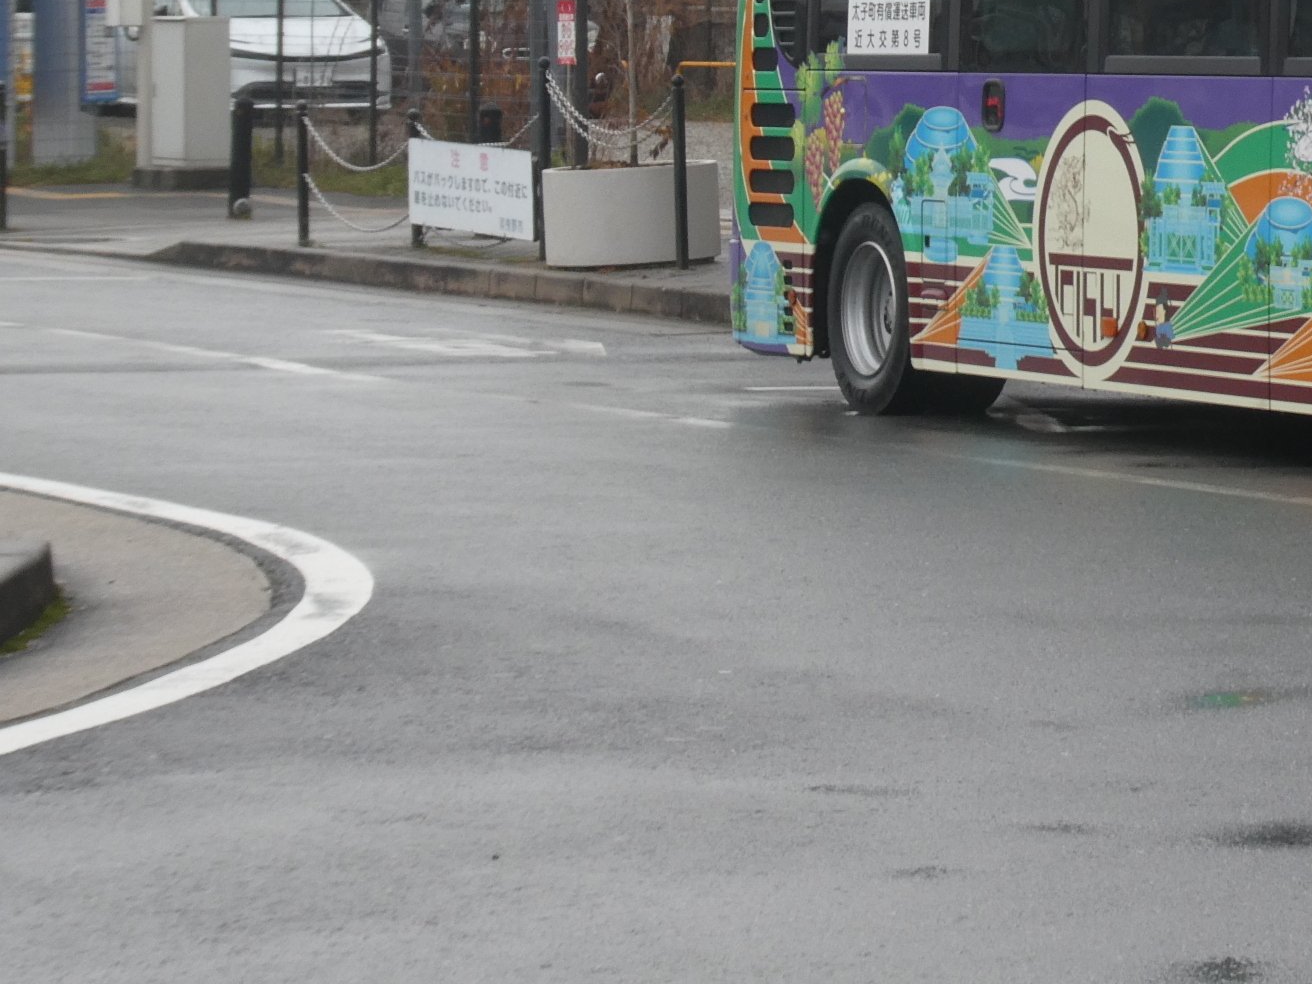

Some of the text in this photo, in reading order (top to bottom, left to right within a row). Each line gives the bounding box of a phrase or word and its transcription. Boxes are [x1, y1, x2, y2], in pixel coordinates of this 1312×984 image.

[852, 1, 926, 21] 太子町有償運送車両
